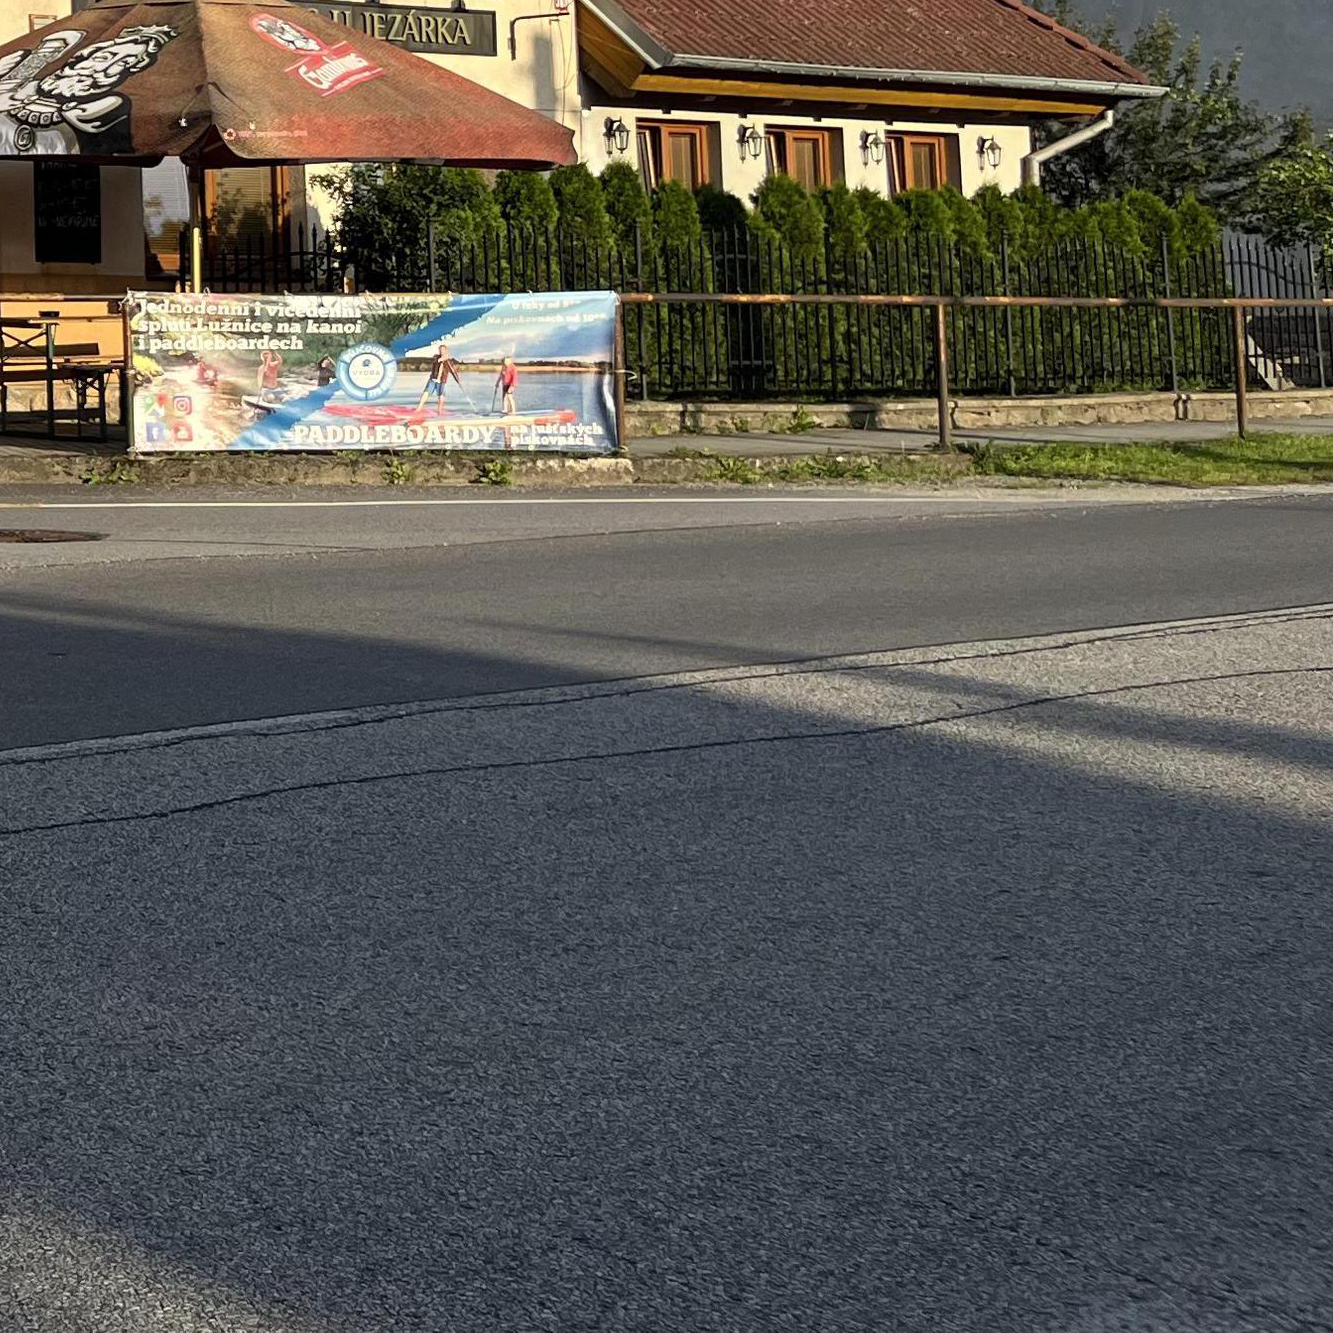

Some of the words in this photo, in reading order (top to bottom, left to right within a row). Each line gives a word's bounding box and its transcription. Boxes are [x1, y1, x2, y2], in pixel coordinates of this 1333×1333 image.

[362, 9, 472, 45] JEZÁRKA
[254, 302, 261, 316] i
[547, 301, 561, 309] od
[195, 318, 272, 333] Lužnice
[276, 321, 300, 333] na
[305, 319, 362, 334] kanoi
[486, 316, 501, 324] Na
[566, 314, 580, 323] od
[138, 334, 145, 350] i
[148, 335, 303, 352] paddleboardech
[294, 425, 497, 444] PADDLEBOARDY
[510, 426, 528, 434] na
[510, 434, 594, 447] pískovnách
